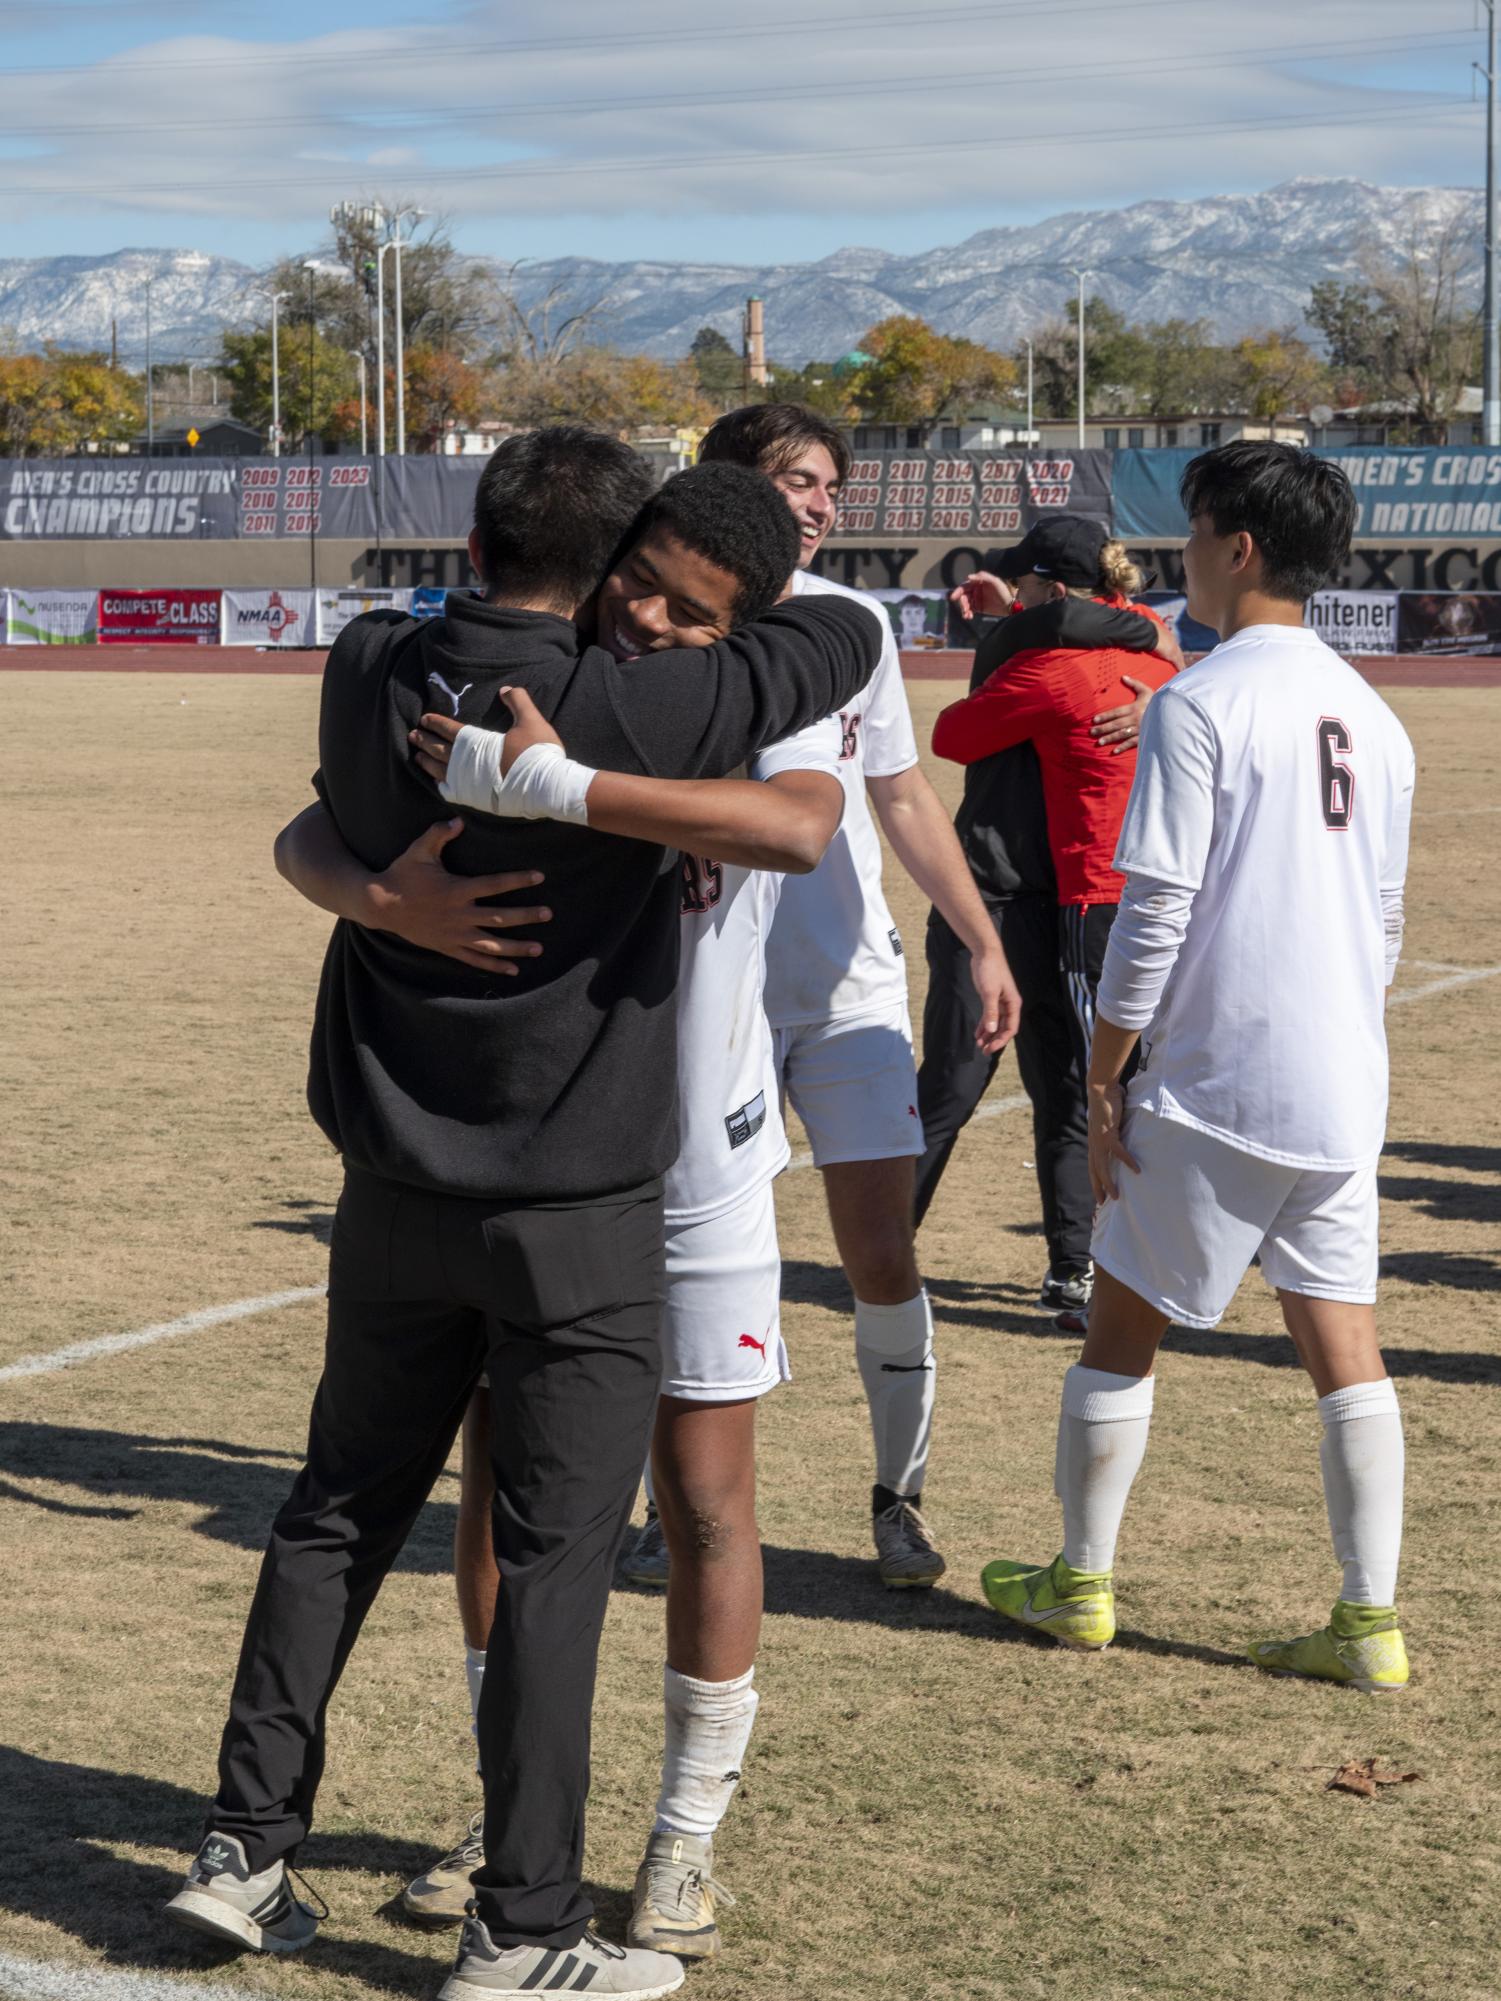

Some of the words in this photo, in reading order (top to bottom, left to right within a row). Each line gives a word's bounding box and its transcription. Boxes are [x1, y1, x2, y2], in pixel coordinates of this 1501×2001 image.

[11, 471, 73, 494] MEN'S
[77, 470, 142, 494] CROSS
[145, 469, 236, 494] COUNTRY
[241, 466, 281, 487] 2009
[285, 466, 322, 487] 2012
[329, 465, 371, 487] 2023
[849, 460, 882, 482] 008
[888, 460, 927, 482] 2011
[933, 460, 974, 482] 2014
[981, 460, 1023, 482] 2017
[1027, 460, 1074, 483] 2020
[1322, 456, 1426, 486] MEN'S
[242, 489, 278, 510] 2010
[837, 485, 881, 507] 2009
[885, 485, 927, 507] 2012
[931, 484, 975, 507] 2015
[980, 484, 1021, 507] 2018
[1028, 484, 1071, 507] 2021
[4, 498, 198, 533] CHAMPIONS
[244, 513, 277, 534] 2011
[285, 512, 321, 534] 2014
[834, 509, 876, 531] 2010
[884, 509, 926, 531] 2013
[930, 509, 972, 531] 2016
[978, 509, 1021, 531] 2019
[103, 599, 167, 615] COMPETE
[170, 602, 218, 624] CLASS
[237, 609, 282, 624] NMAA
[1316, 715, 1354, 831] 6
